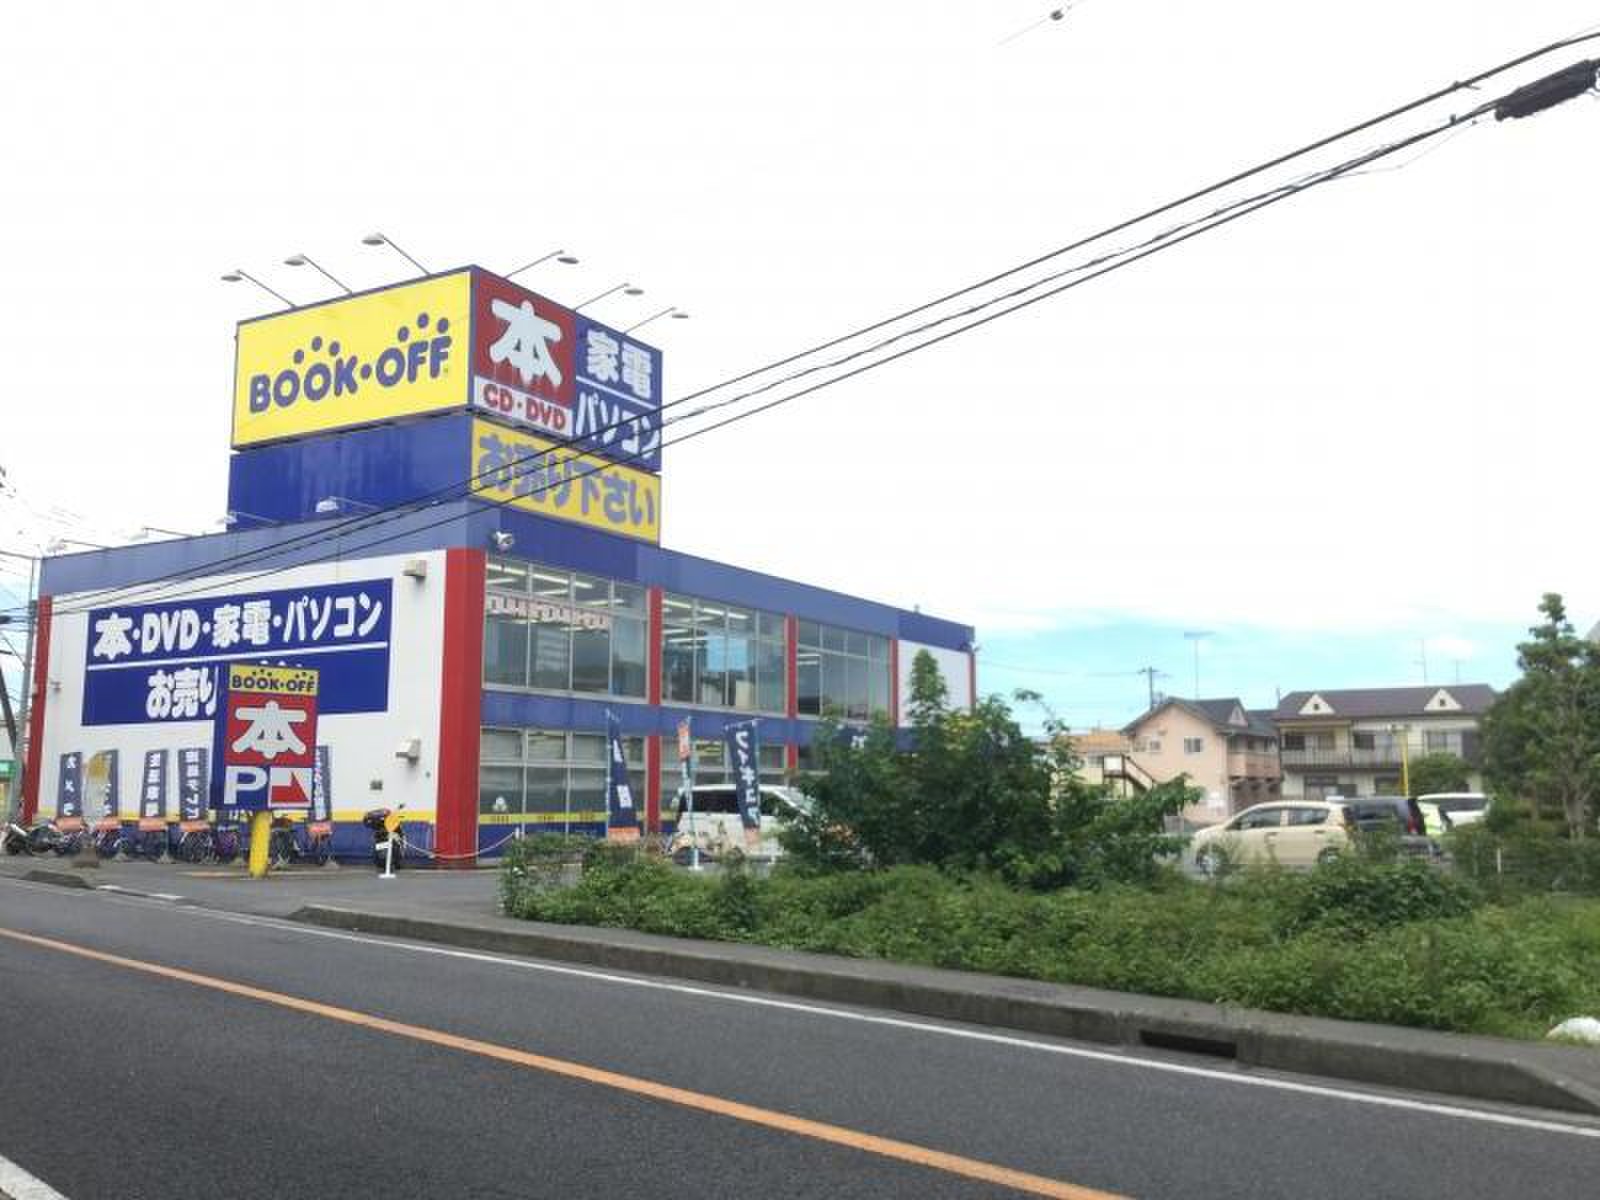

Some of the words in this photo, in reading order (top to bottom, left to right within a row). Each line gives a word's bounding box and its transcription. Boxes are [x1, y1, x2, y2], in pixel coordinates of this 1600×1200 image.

[490, 299, 562, 390] 本
[587, 329, 652, 399] 家電
[576, 392, 660, 457] パソコン
[479, 434, 655, 526] お売り下さい
[232, 700, 306, 759] 本
[223, 766, 267, 804] P
